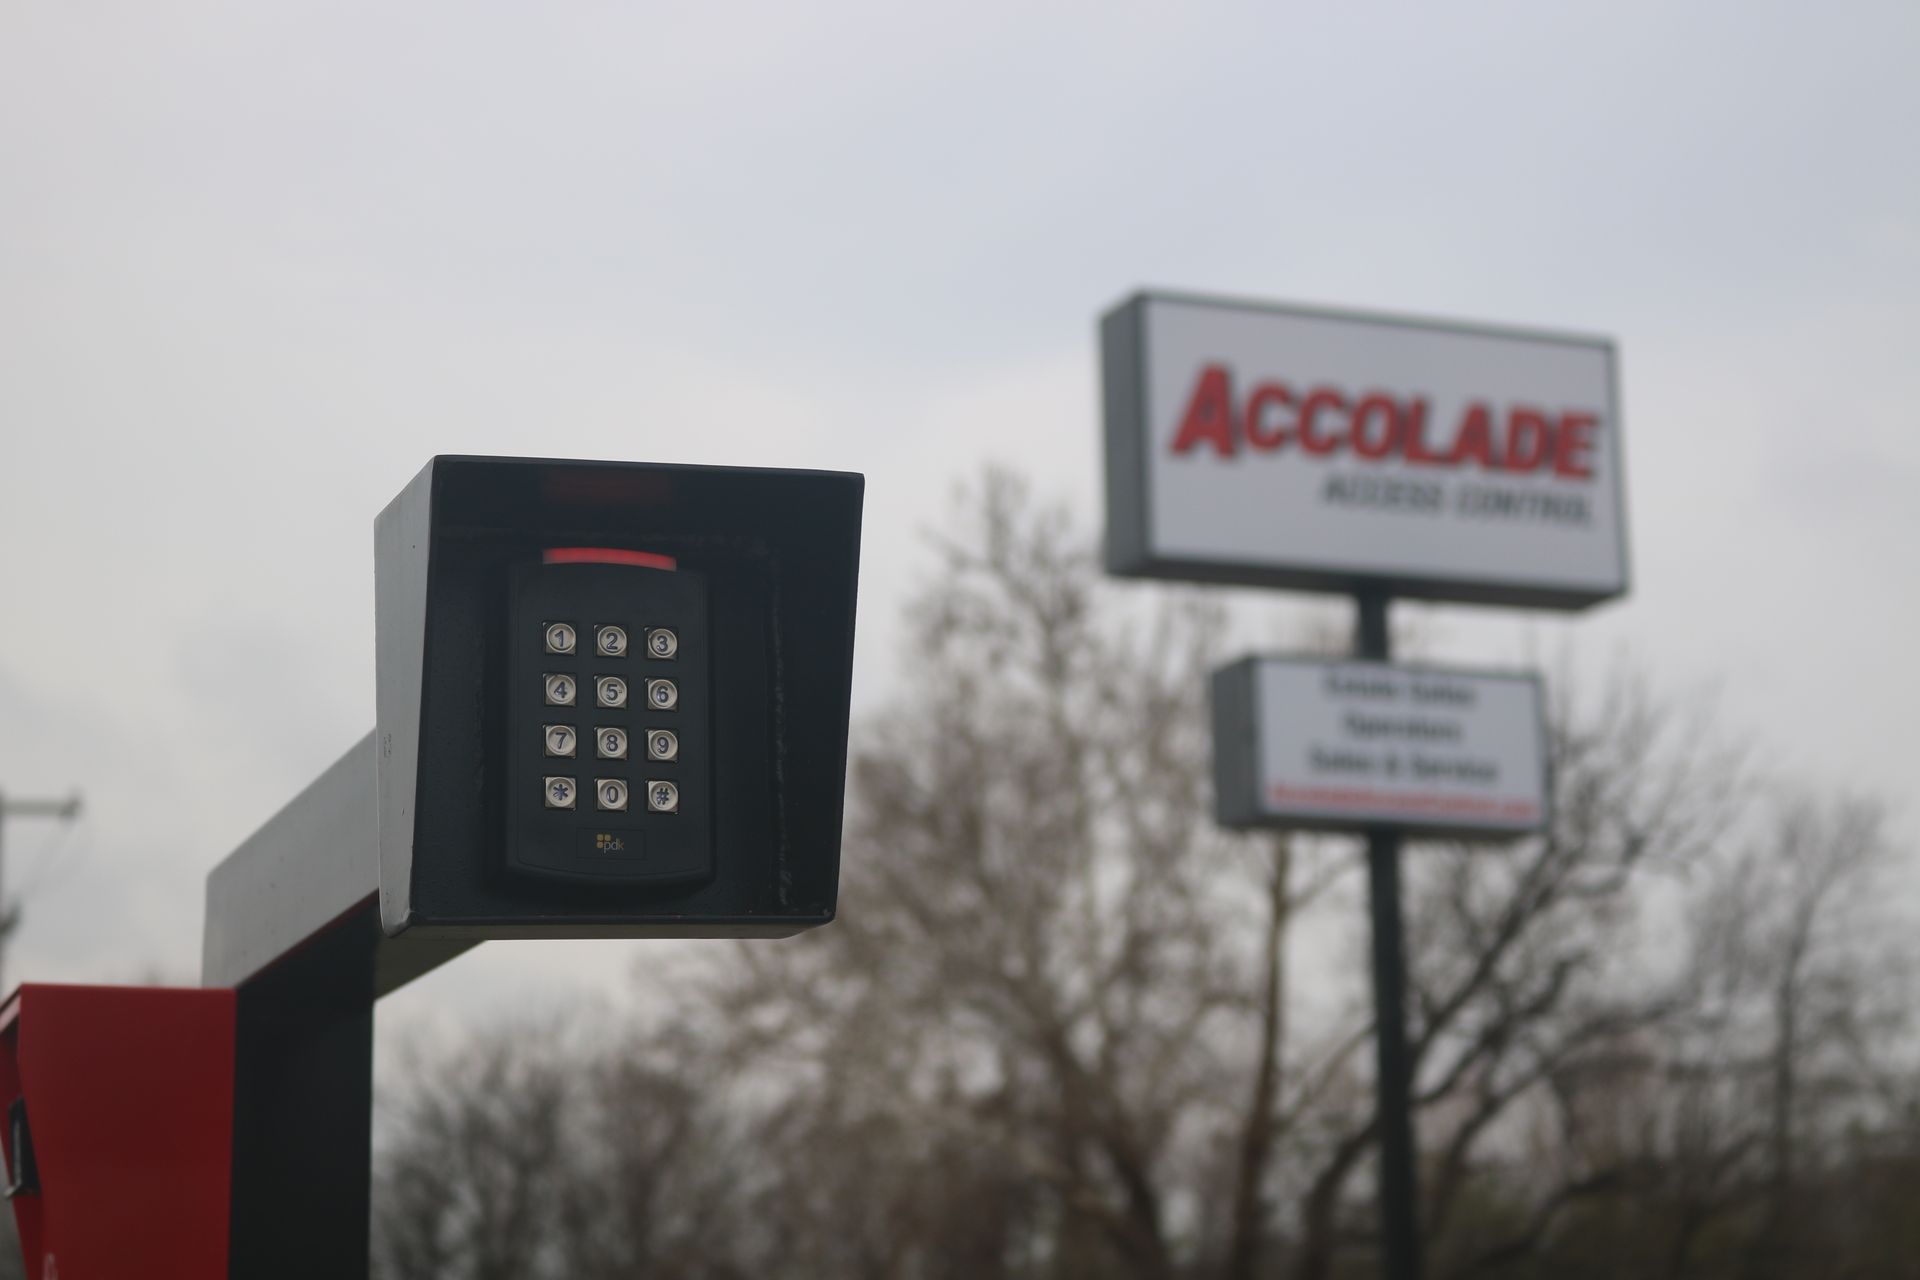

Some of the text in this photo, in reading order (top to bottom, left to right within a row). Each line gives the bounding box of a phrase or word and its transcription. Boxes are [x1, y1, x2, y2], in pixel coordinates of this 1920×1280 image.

[1170, 361, 1598, 480] ACCOLADE
[1321, 474, 1594, 528] ACCESS CONTROL
[554, 630, 668, 652] 1 2 3
[554, 681, 668, 703] 4 5 6
[555, 733, 669, 754] 7 8 9
[607, 786, 618, 803] 0
[657, 788, 669, 805] #
[603, 838, 625, 854] pdk
